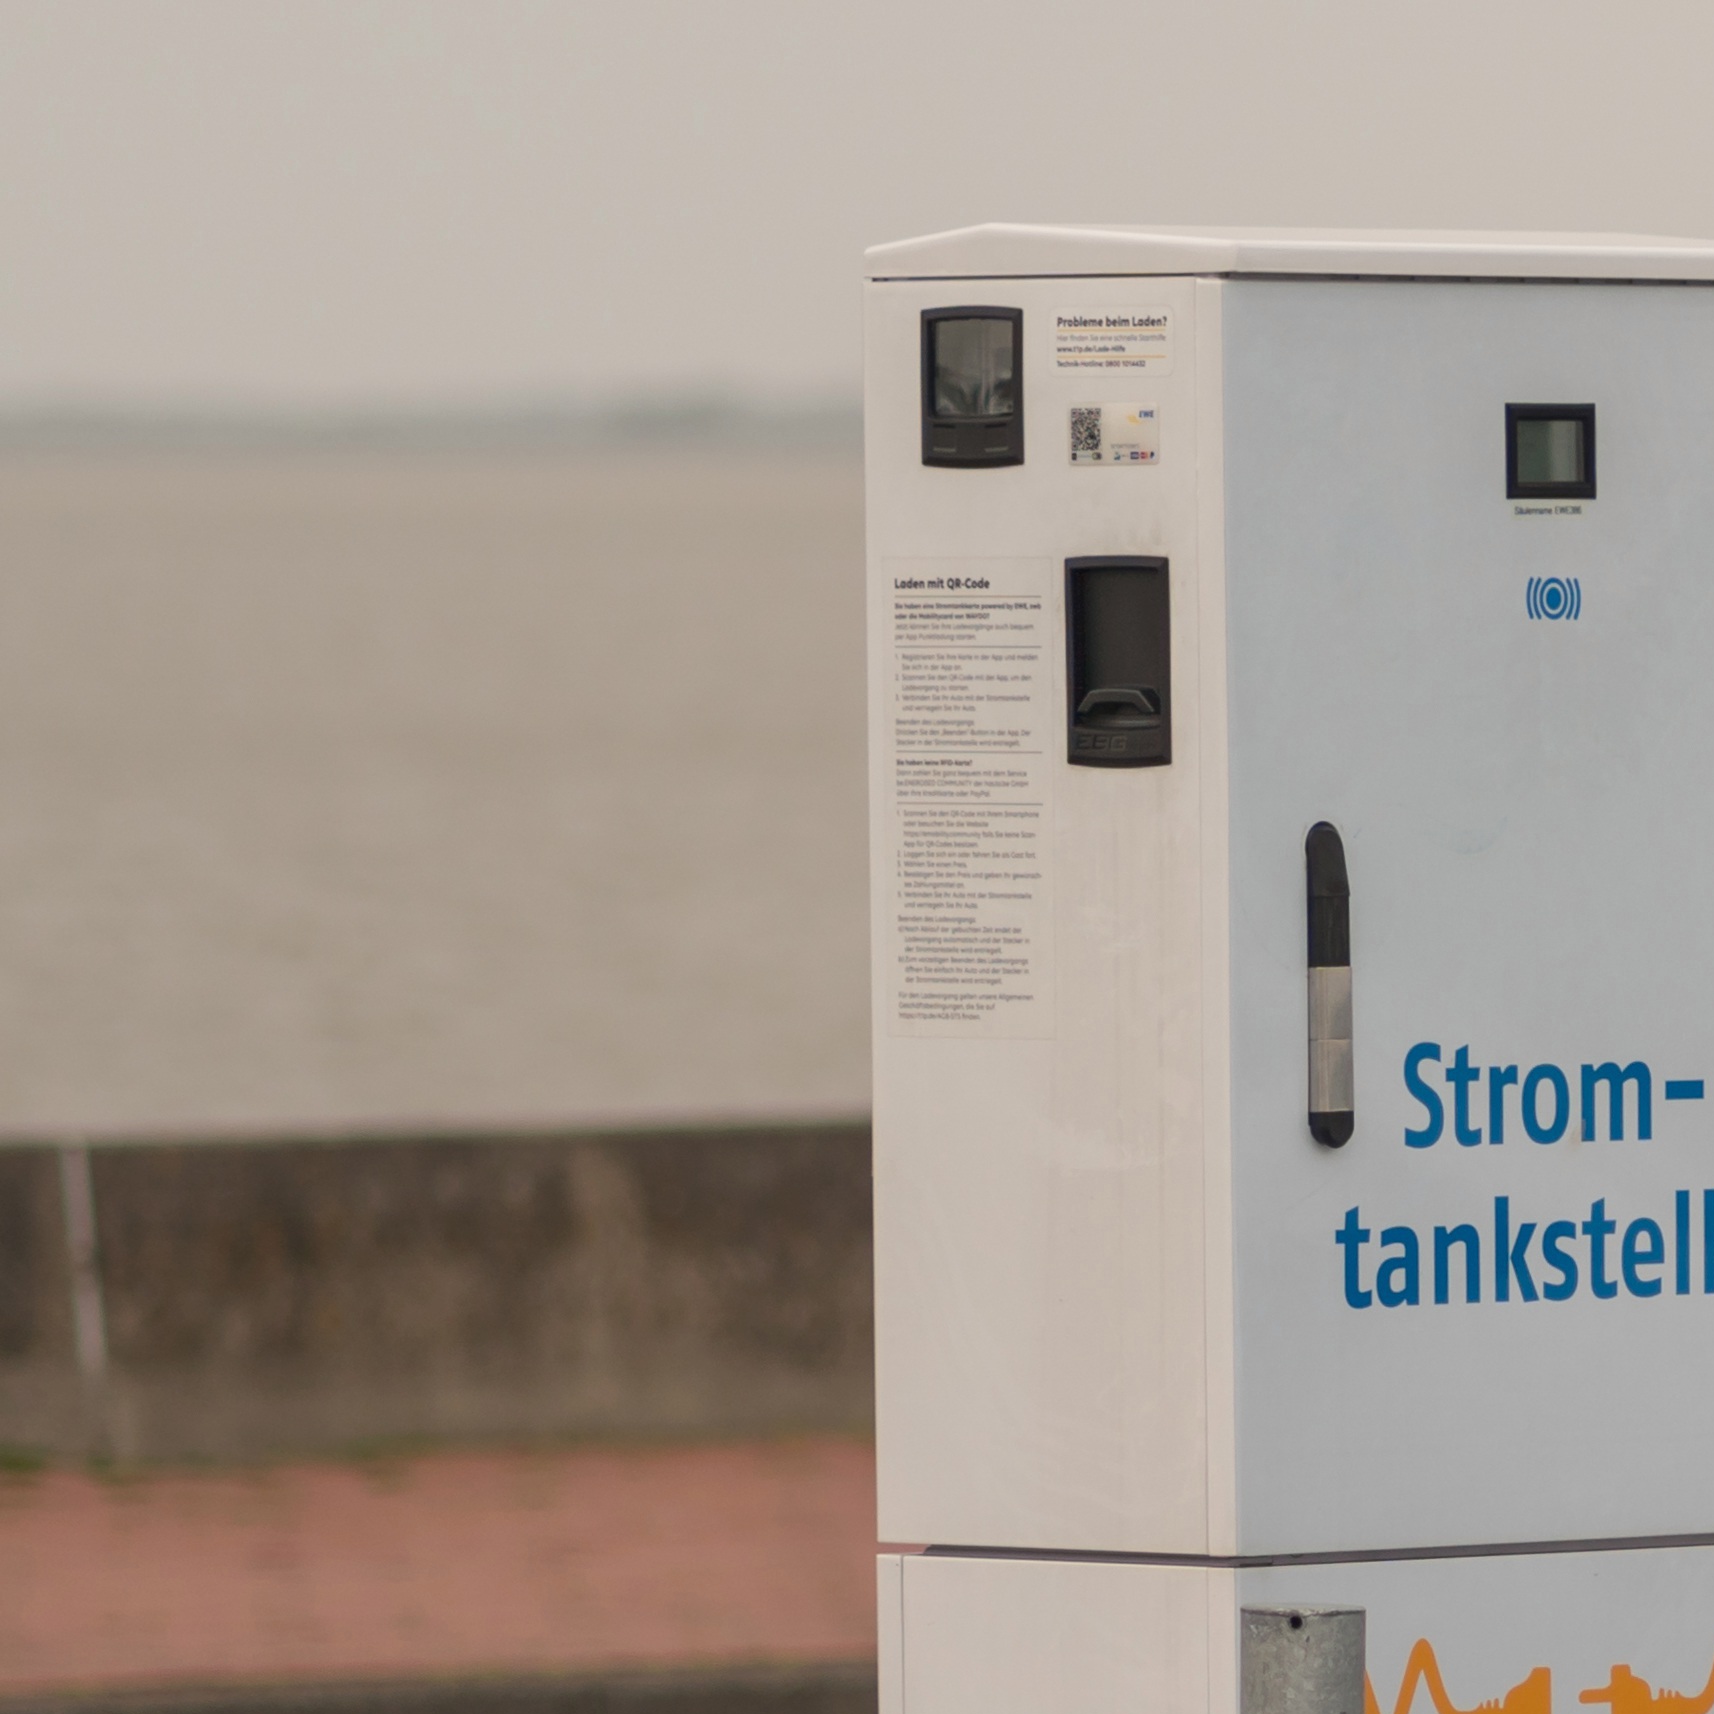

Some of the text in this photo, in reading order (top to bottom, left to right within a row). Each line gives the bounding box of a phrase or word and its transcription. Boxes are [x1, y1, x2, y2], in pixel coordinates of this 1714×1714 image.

[1057, 315, 1167, 327] Probleme beim Laden?
[894, 578, 990, 590] Laden mit QR-Code
[1404, 1042, 1704, 1148] Strom-
